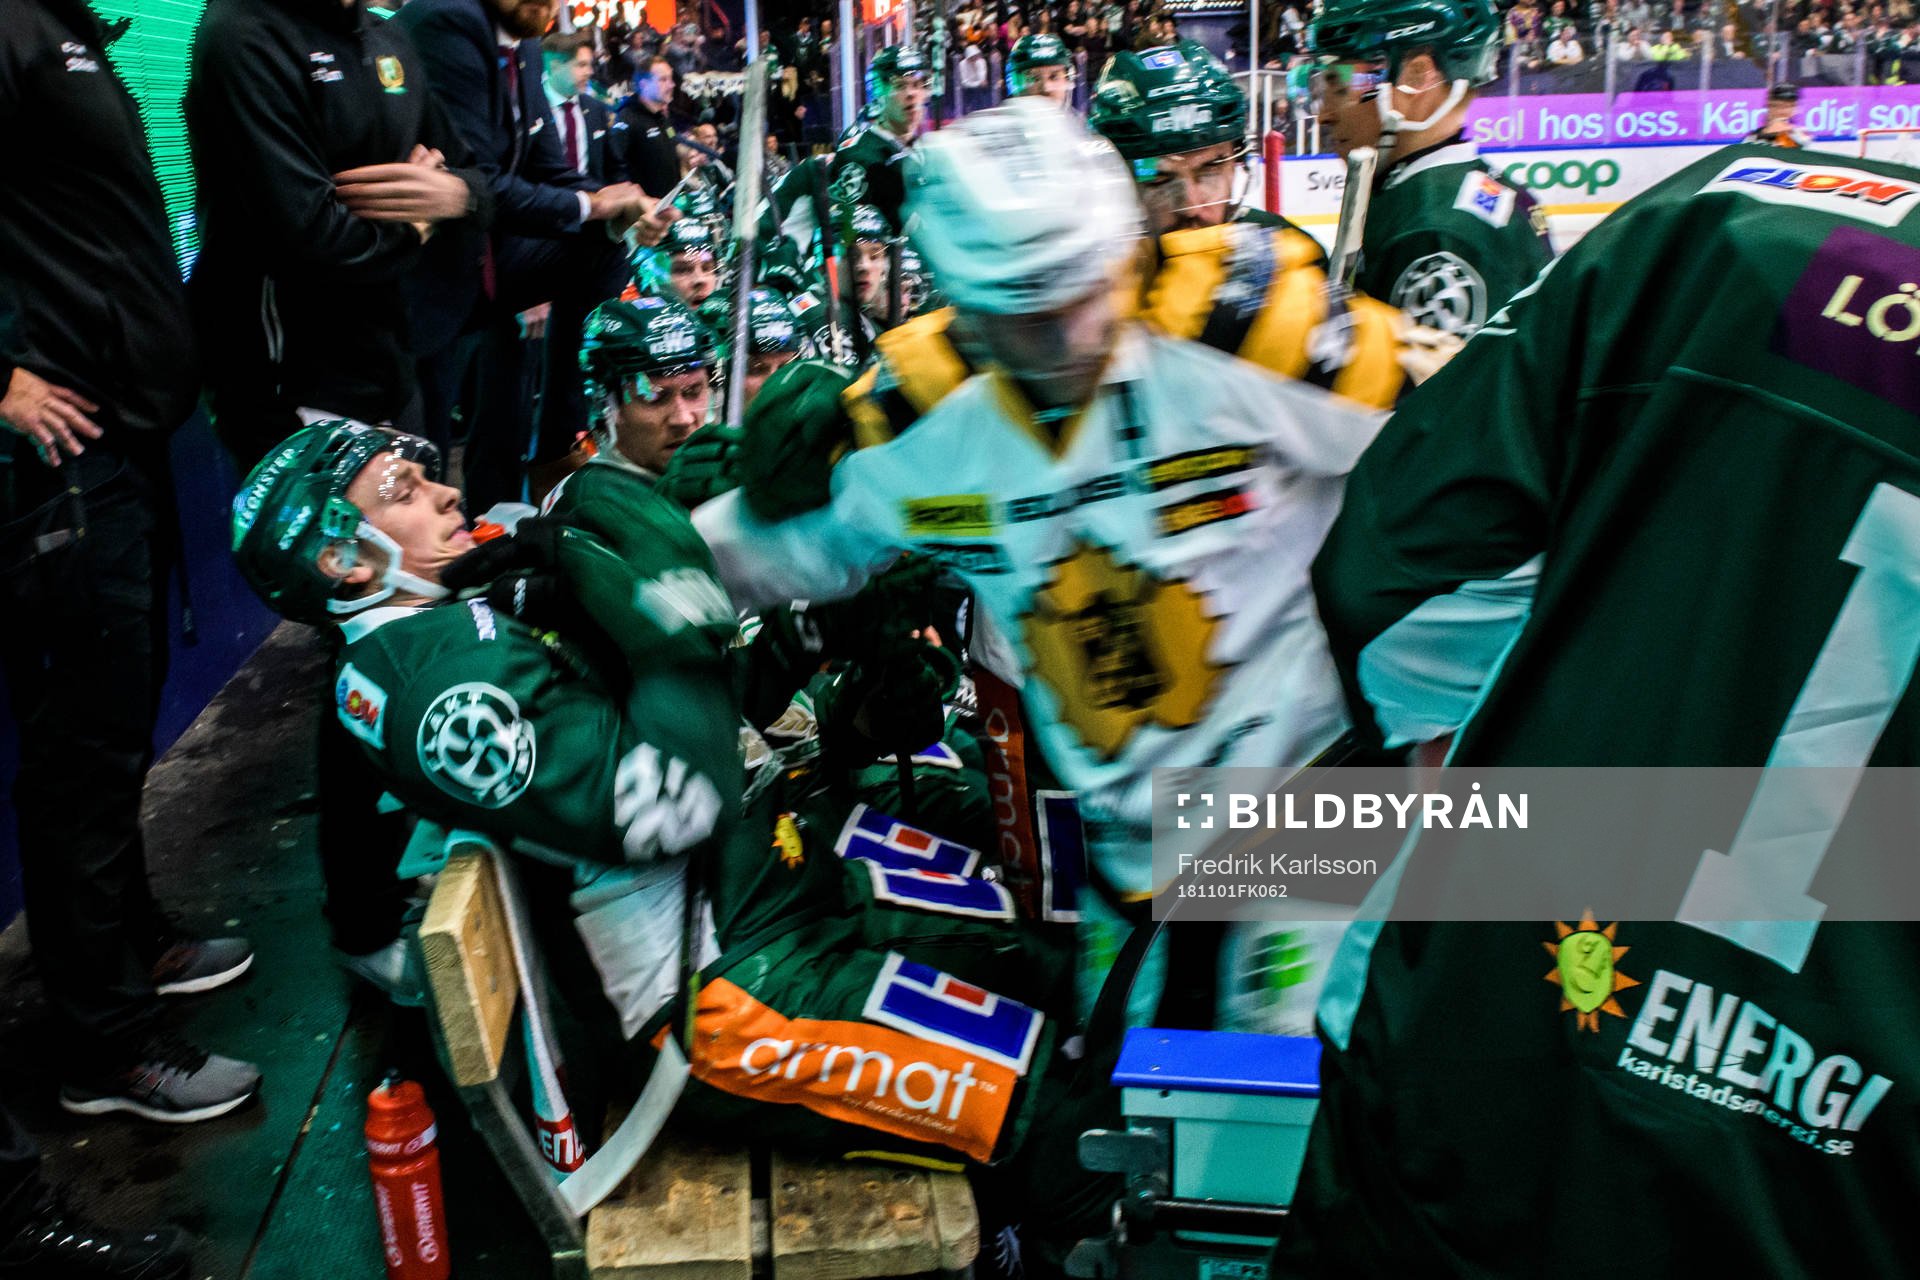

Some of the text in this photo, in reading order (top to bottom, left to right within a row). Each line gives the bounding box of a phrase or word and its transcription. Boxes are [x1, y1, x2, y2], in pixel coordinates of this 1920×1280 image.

[1539, 107, 1603, 140] hos
[1616, 110, 1687, 138] oss.
[1805, 99, 1858, 136] dig
[1869, 104, 1920, 129] so
[1504, 159, 1620, 195] coop
[1721, 167, 1917, 206] ELON
[1821, 274, 1920, 356] LÖ
[740, 1037, 977, 1120] armat
[1627, 968, 1894, 1132] ENERGI
[1617, 1047, 1855, 1156] karlstadsenergi.se
